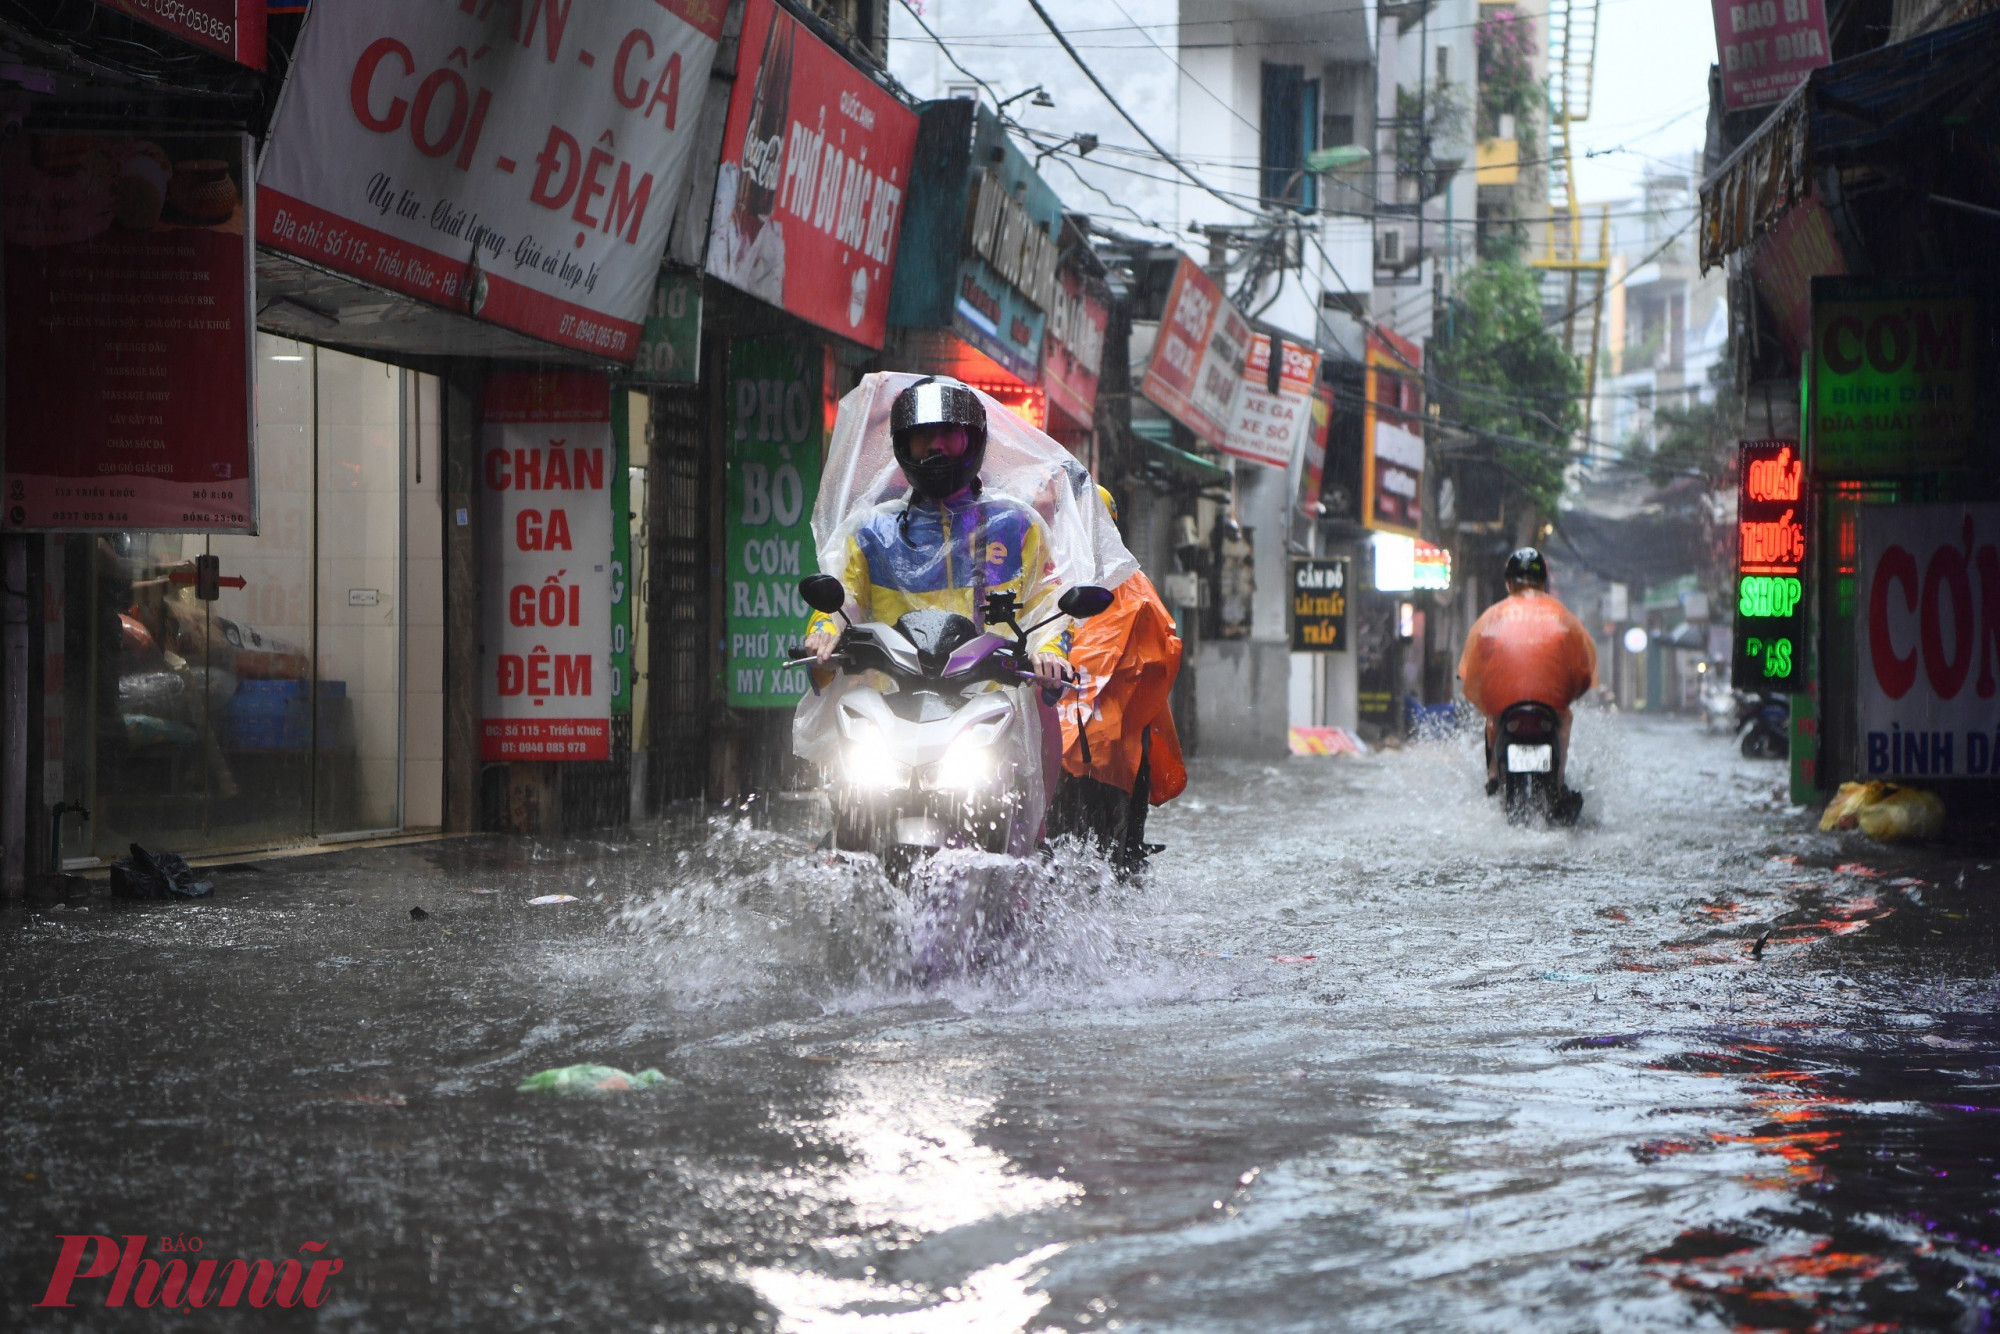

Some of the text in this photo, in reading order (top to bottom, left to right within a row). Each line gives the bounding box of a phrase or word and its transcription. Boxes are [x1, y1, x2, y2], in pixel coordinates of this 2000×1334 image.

[1730, 0, 1777, 34] BAO
[350, 37, 494, 172] GỐI
[530, 125, 654, 249] ĐỆM
[780, 104, 826, 222] PHỞ
[814, 128, 844, 235] BÒ
[836, 145, 872, 265] ĐẶC
[863, 166, 902, 281] BIỆT
[366, 172, 394, 216] Uy
[514, 235, 543, 270] Giá
[272, 209, 295, 243] Địa
[296, 219, 324, 250] chỉ:
[323, 228, 347, 257] Số
[343, 237, 368, 265] 115
[374, 248, 403, 278] Triều
[405, 258, 435, 289] Khúc
[440, 270, 457, 296] Hà
[192, 271, 210, 281] 39K
[104, 342, 147, 352] MASSAGE
[610, 329, 627, 351] 978
[1822, 306, 1963, 375] CƠM
[104, 367, 147, 377] MASSAGE
[102, 390, 170, 401] MASSAGE BODY
[735, 350, 811, 444] PHỞ
[148, 415, 163, 425] TAI
[135, 437, 152, 449] SÓC
[485, 439, 604, 491] CHĂN
[211, 491, 234, 500] 8:00
[741, 445, 804, 527] BÒ
[53, 512, 79, 521] 0327
[183, 511, 210, 522] ĐÓNG
[214, 513, 244, 523] 23:00
[516, 508, 573, 551] GA
[744, 534, 800, 577] CƠM
[509, 569, 580, 627] GỐI
[1740, 576, 1802, 617] SHOP
[732, 626, 770, 659] PHỞ
[496, 645, 592, 706] ĐỆM
[505, 724, 519, 736] Số
[521, 725, 540, 736] 115
[548, 724, 575, 736] Triều
[576, 724, 603, 736] Khúc
[518, 742, 544, 753] 0946
[546, 742, 565, 753] 085
[567, 742, 586, 753] 978
[1868, 721, 1954, 774] BÌNH
